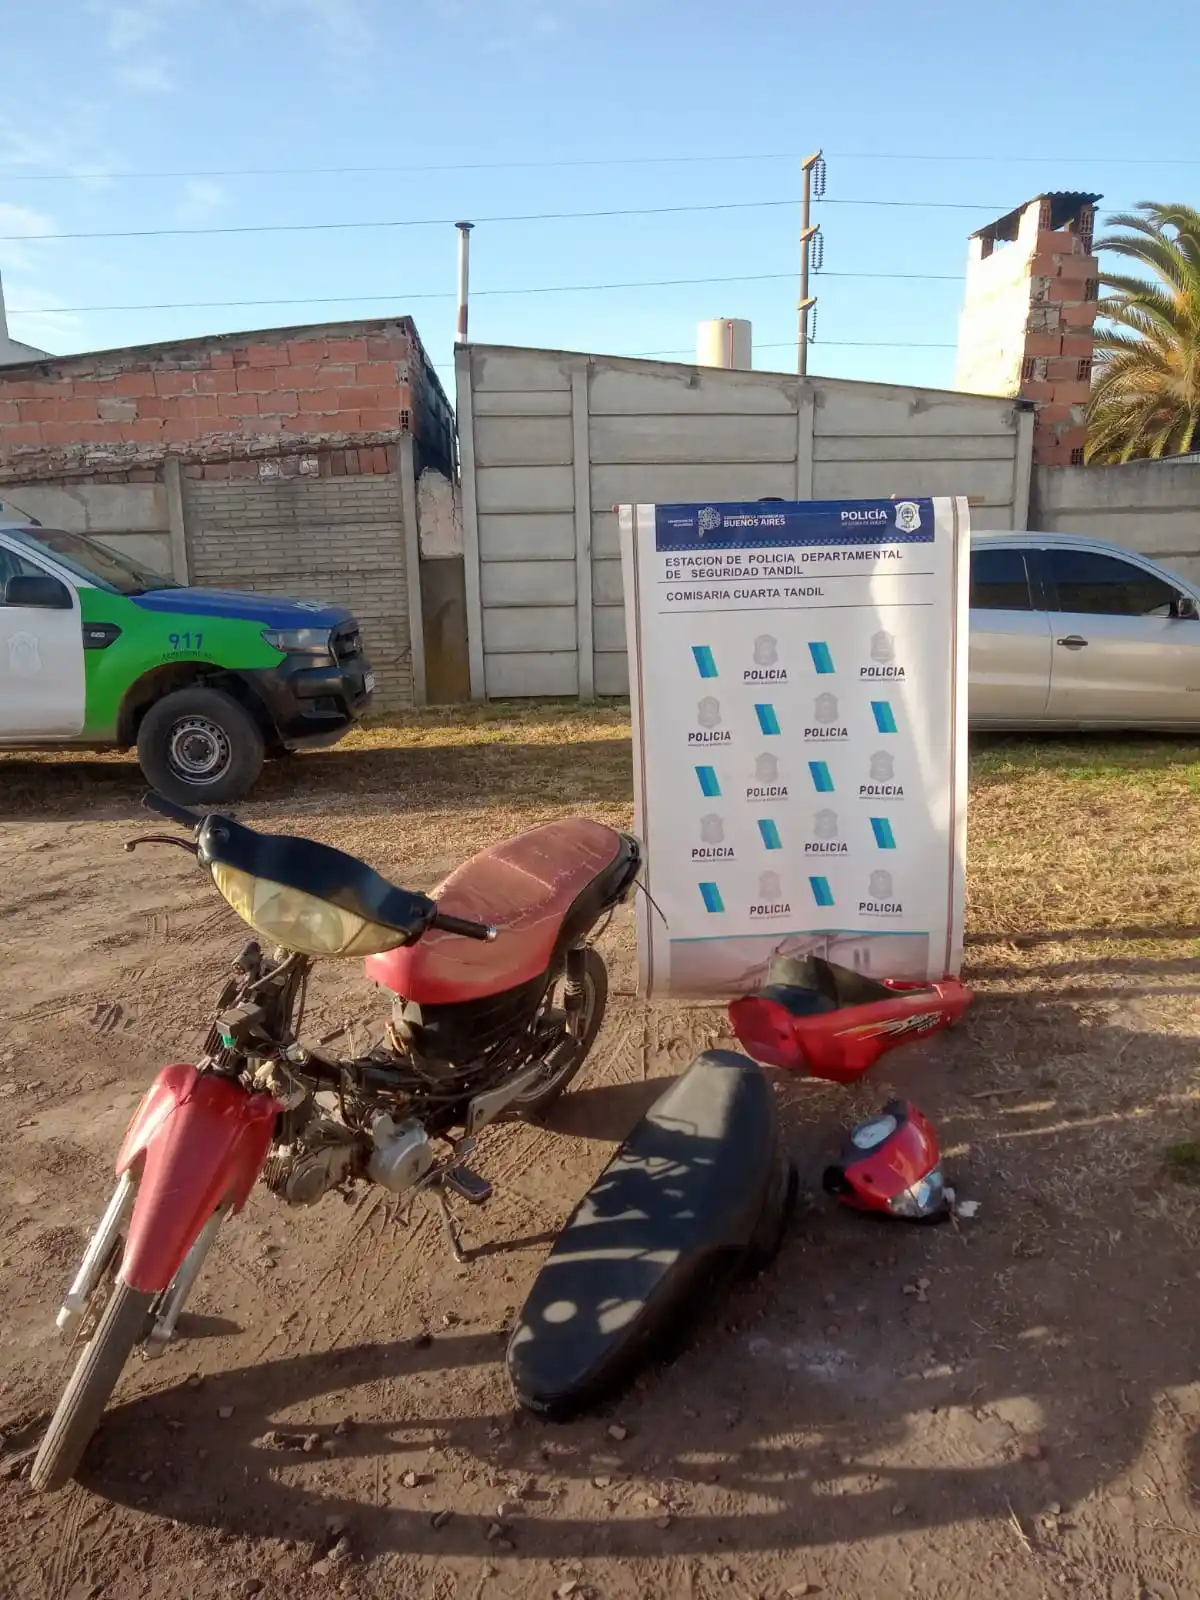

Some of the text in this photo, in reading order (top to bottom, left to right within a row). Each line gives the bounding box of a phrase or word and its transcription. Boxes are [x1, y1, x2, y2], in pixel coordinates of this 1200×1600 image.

[841, 508, 888, 520] POLICÍA
[723, 518, 786, 527] BUENOS AIRES
[665, 550, 903, 567] ESTACION DE POLICIA DEPARTAMENTAL
[666, 566, 804, 579] DE SEGURIDAD TANDIL
[666, 587, 825, 602] COMISARIA CUARTA TANDIL
[168, 631, 203, 650] 911
[743, 669, 788, 680] POLICIA
[859, 666, 906, 677] POLICIA
[688, 731, 732, 742] POLICIA
[804, 727, 849, 738] POLICIA
[746, 787, 789, 798] POLICIA
[859, 785, 904, 796] POLICIA
[691, 847, 735, 858] POLICIA
[804, 842, 848, 853] POLICIA
[749, 904, 792, 915] POLICIA
[858, 902, 903, 913] POLICIA
